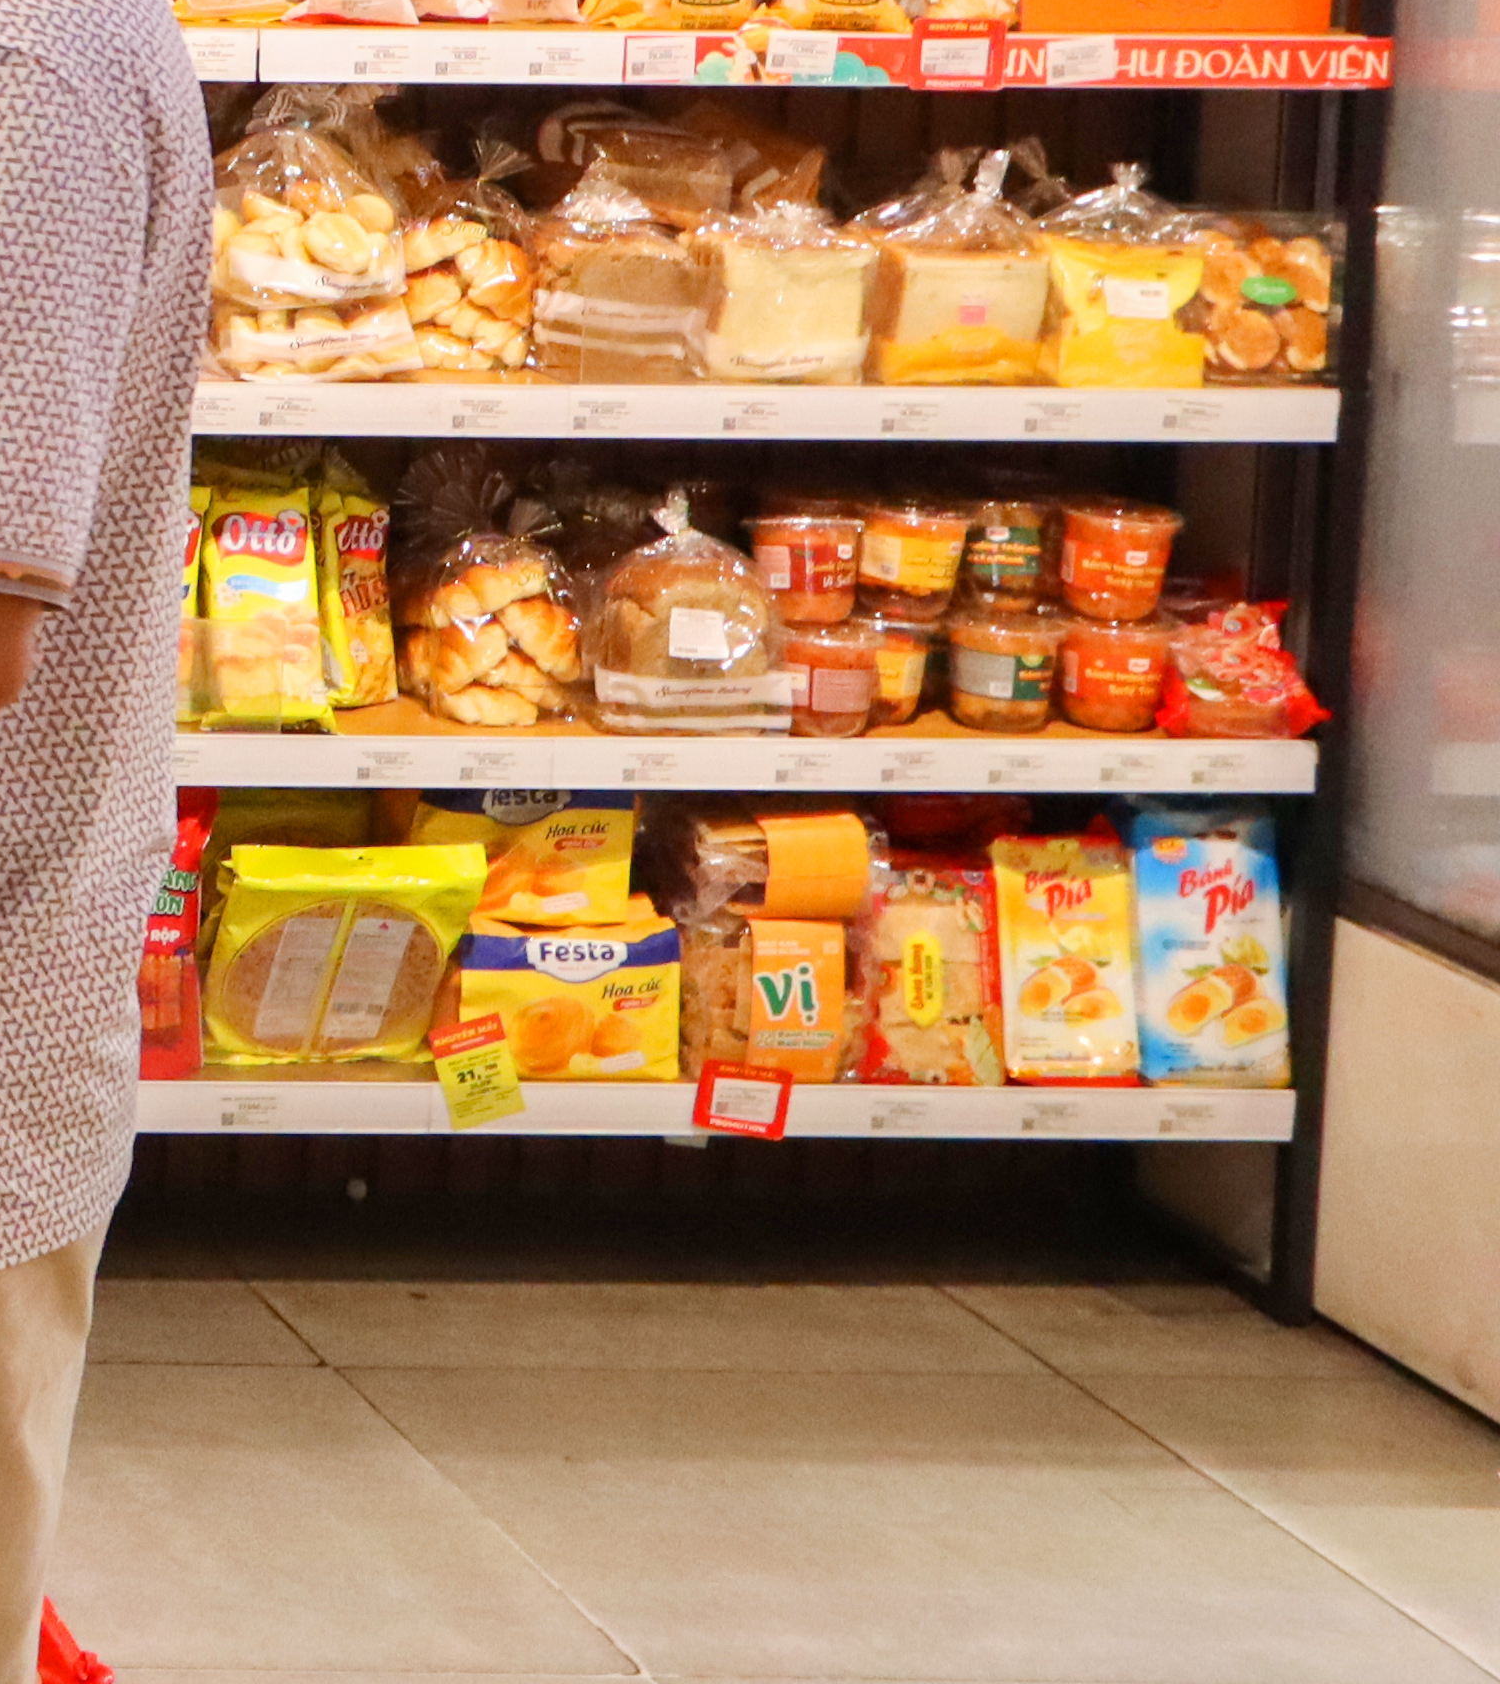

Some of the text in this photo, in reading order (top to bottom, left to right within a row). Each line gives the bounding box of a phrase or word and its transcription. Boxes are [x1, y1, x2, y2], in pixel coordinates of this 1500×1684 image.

[1175, 38, 1390, 81] ĐOÀN VIÊN
[222, 514, 297, 556] Otto
[545, 821, 579, 840] Hoa
[538, 941, 616, 964] Festa
[601, 982, 633, 1000] Hoa
